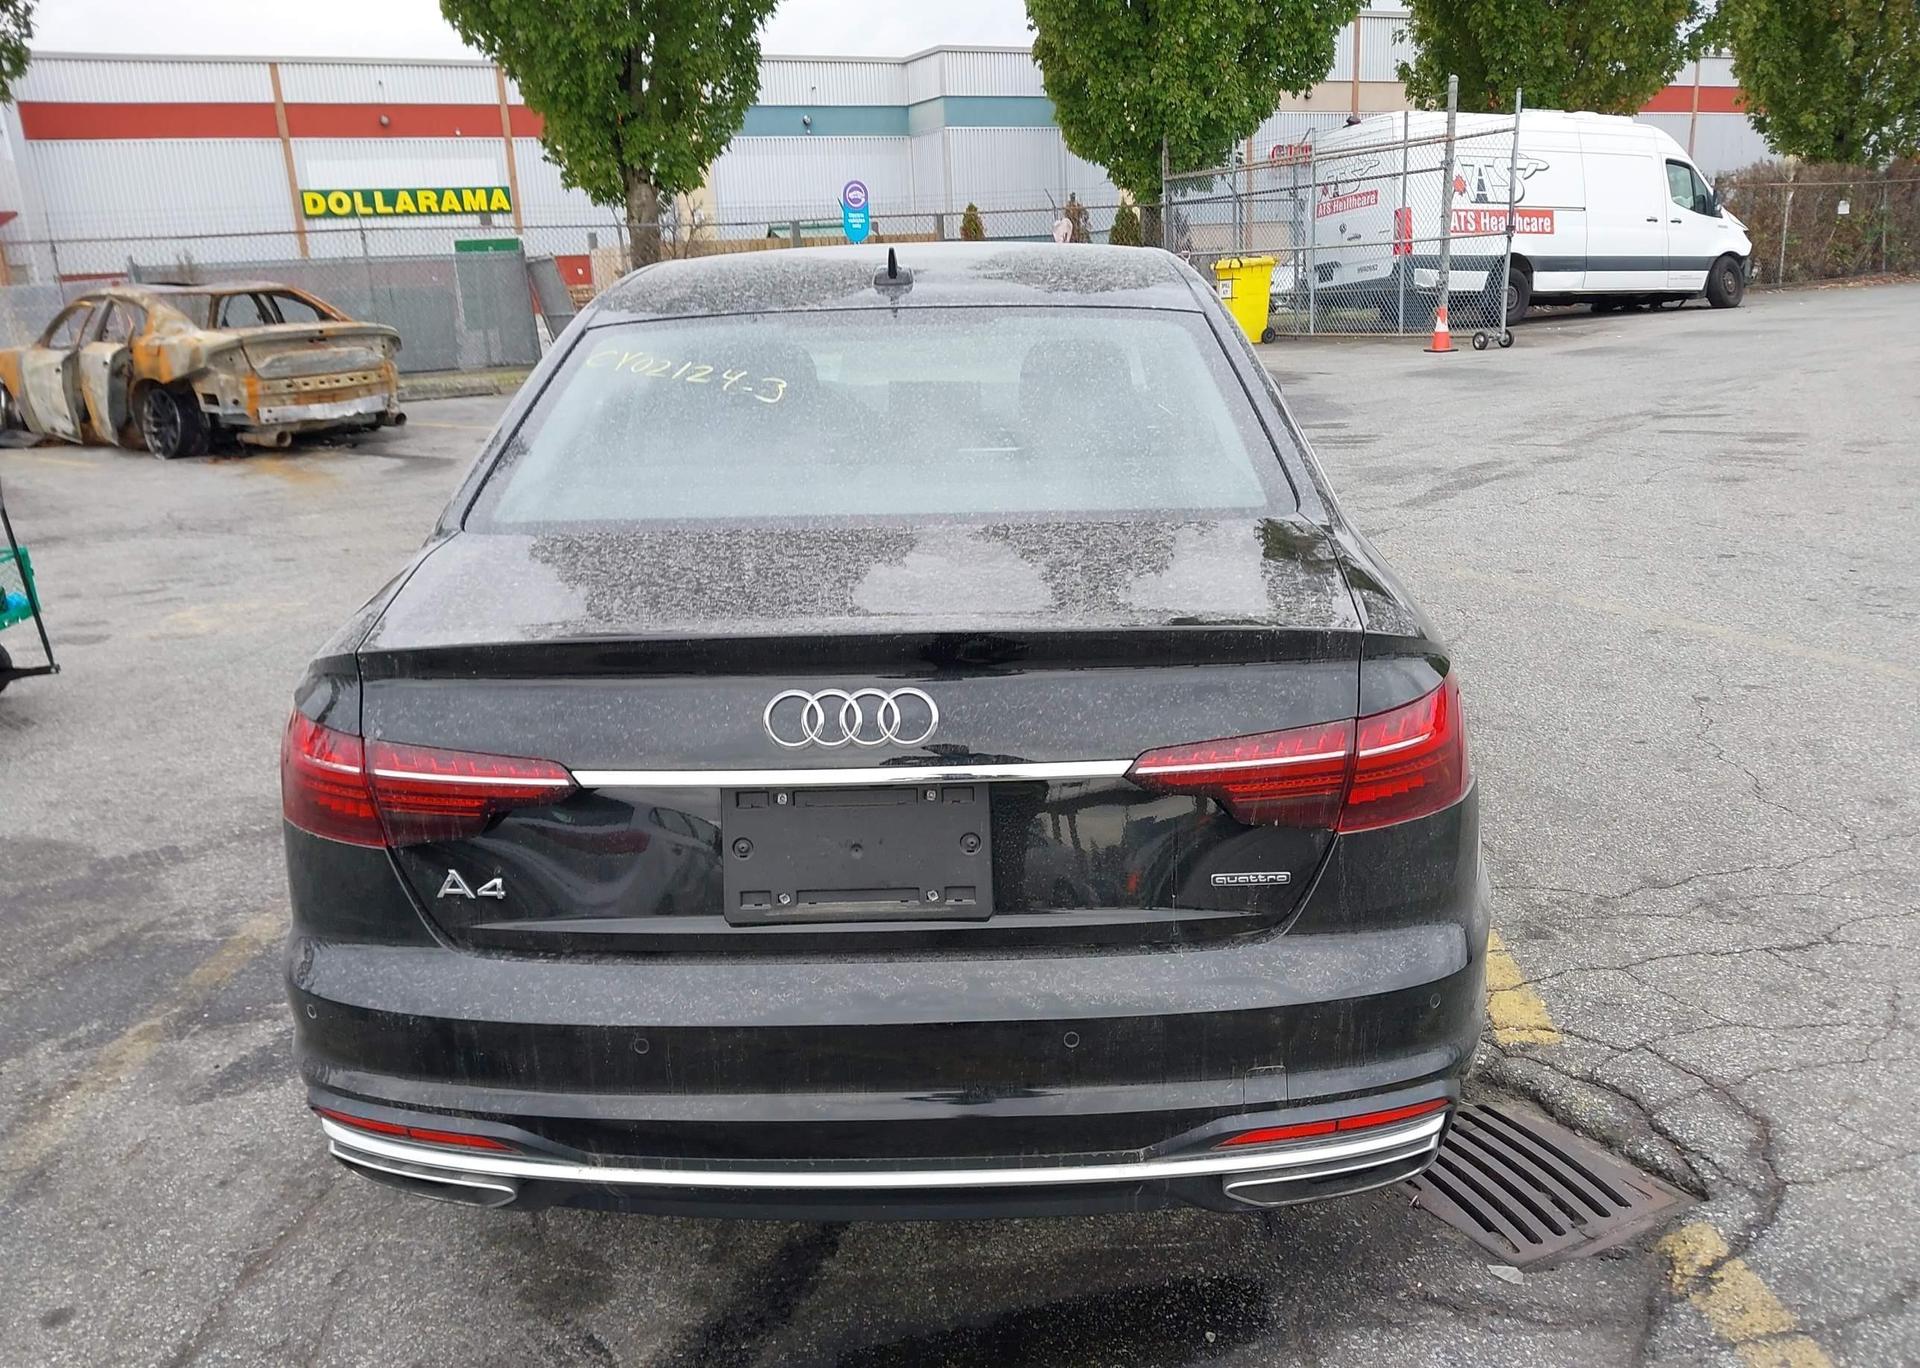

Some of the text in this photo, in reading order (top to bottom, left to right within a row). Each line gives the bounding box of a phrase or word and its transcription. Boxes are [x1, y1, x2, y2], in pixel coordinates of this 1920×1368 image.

[302, 188, 511, 216] DOLLARAMA
[1317, 193, 1377, 217] ATS Healthcare
[1450, 211, 1476, 231] ATS
[585, 350, 788, 404] CY02124-3
[437, 868, 506, 900] A4
[1215, 874, 1287, 885] quattro
